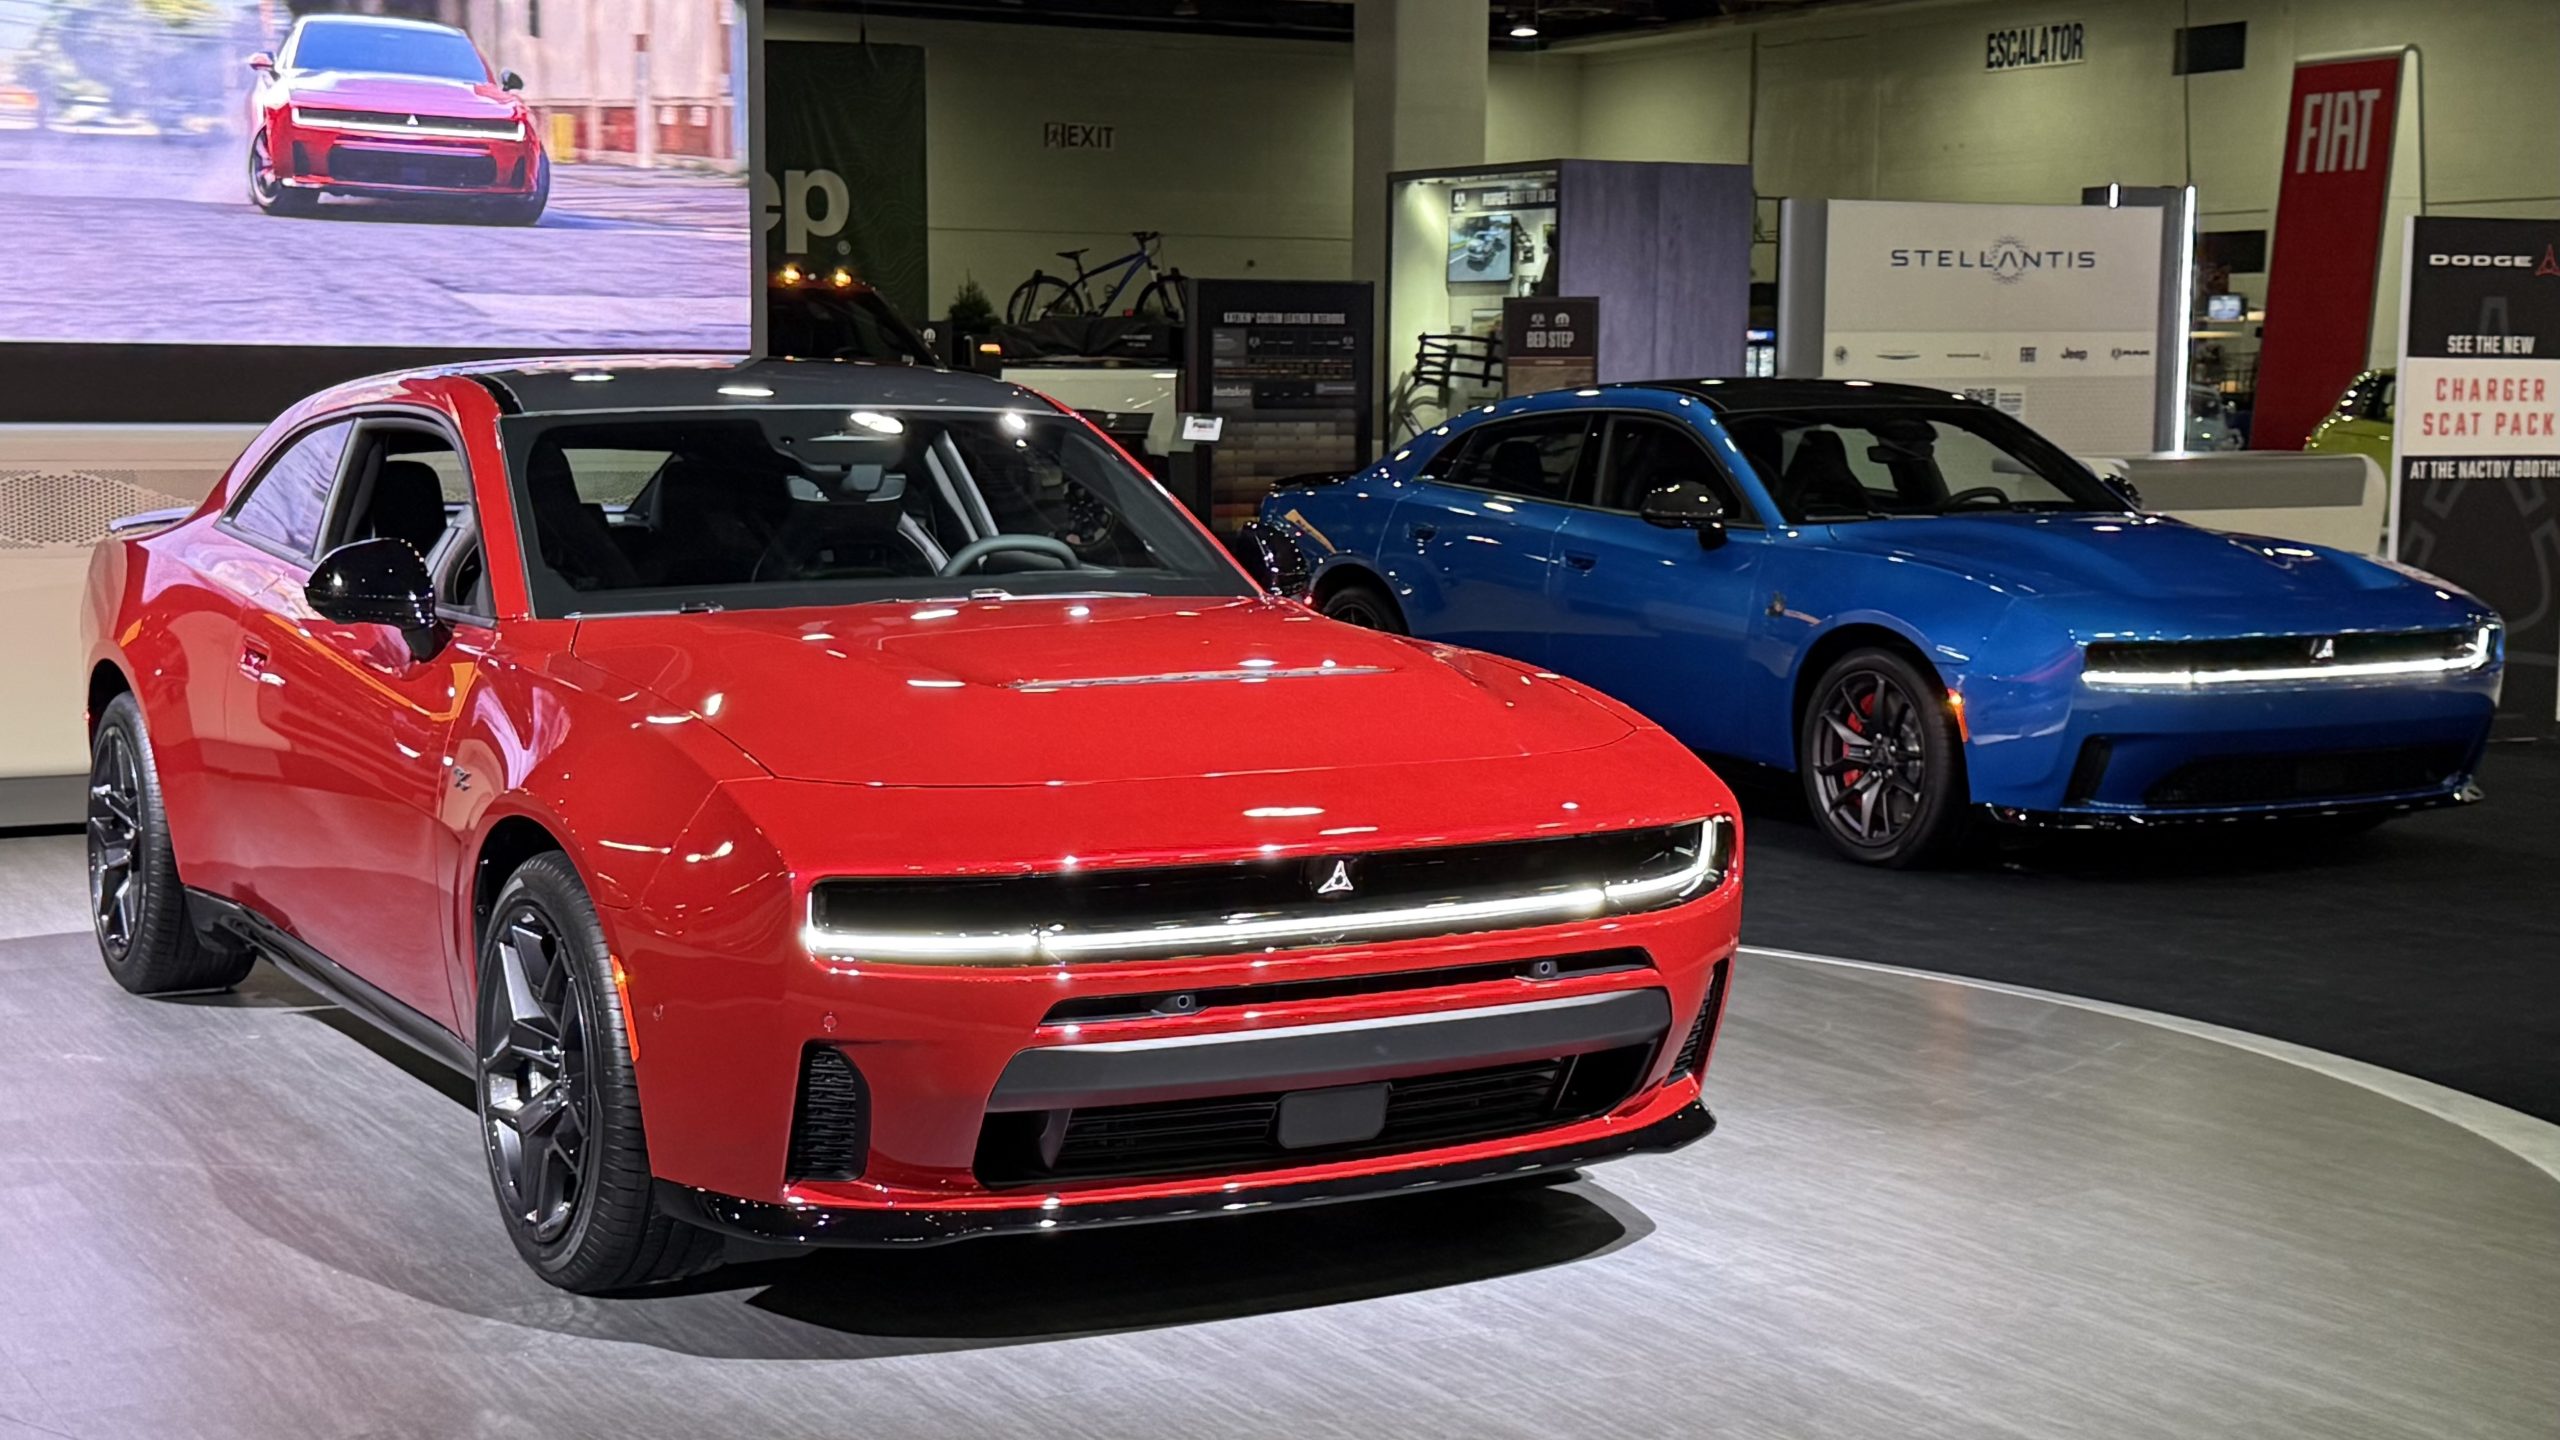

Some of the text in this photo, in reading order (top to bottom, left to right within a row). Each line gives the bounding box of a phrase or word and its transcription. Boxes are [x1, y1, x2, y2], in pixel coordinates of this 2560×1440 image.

[1986, 23, 2084, 69] ESCALATOR
[1067, 125, 1115, 148] EXIT
[2296, 88, 2381, 174] FIAT
[1891, 249, 2096, 268] STELLANTIS
[2429, 254, 2533, 268] DODGE
[1526, 331, 1574, 348] BED STEP
[2447, 335, 2536, 355] SEE THE NEW
[2060, 347, 2088, 361] Jeep
[2436, 377, 2545, 402] CHARGER
[2422, 412, 2554, 436] SCAT PACK
[2410, 461, 2428, 479] AT
[2430, 461, 2456, 479] THE
[2458, 460, 2512, 479] NACTOY
